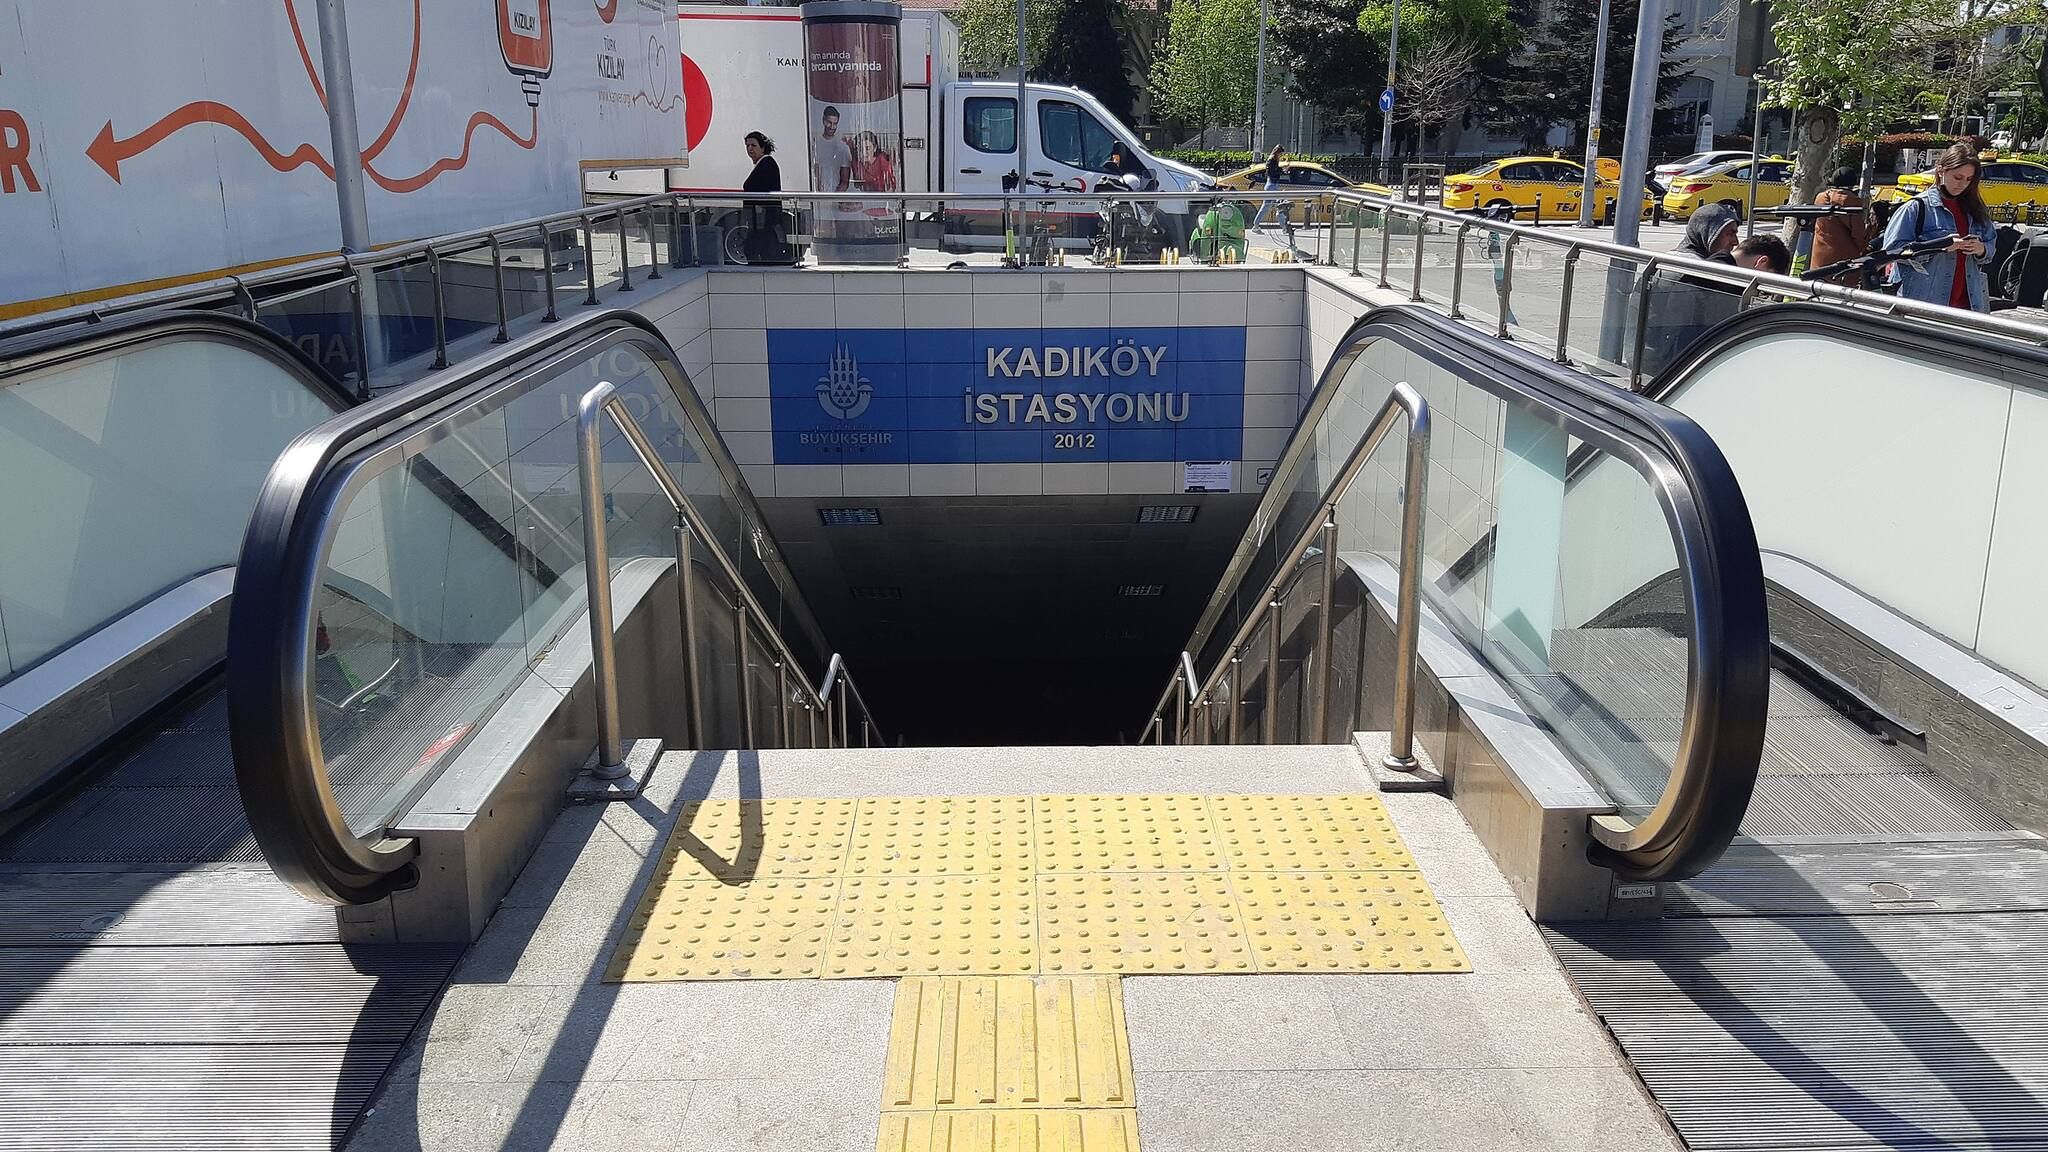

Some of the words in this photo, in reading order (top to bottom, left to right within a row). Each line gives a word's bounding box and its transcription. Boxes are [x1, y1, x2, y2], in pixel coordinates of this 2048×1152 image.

[513, 11, 536, 32] KIZILAY
[597, 53, 625, 80] KIZILAY
[776, 58, 799, 67] KAN
[838, 61, 882, 72] yanında
[1555, 202, 1578, 212] TEJ
[986, 338, 1168, 378] KADIKÖY
[965, 386, 1190, 424] İSTASYONU
[1054, 433, 1096, 449] 2012
